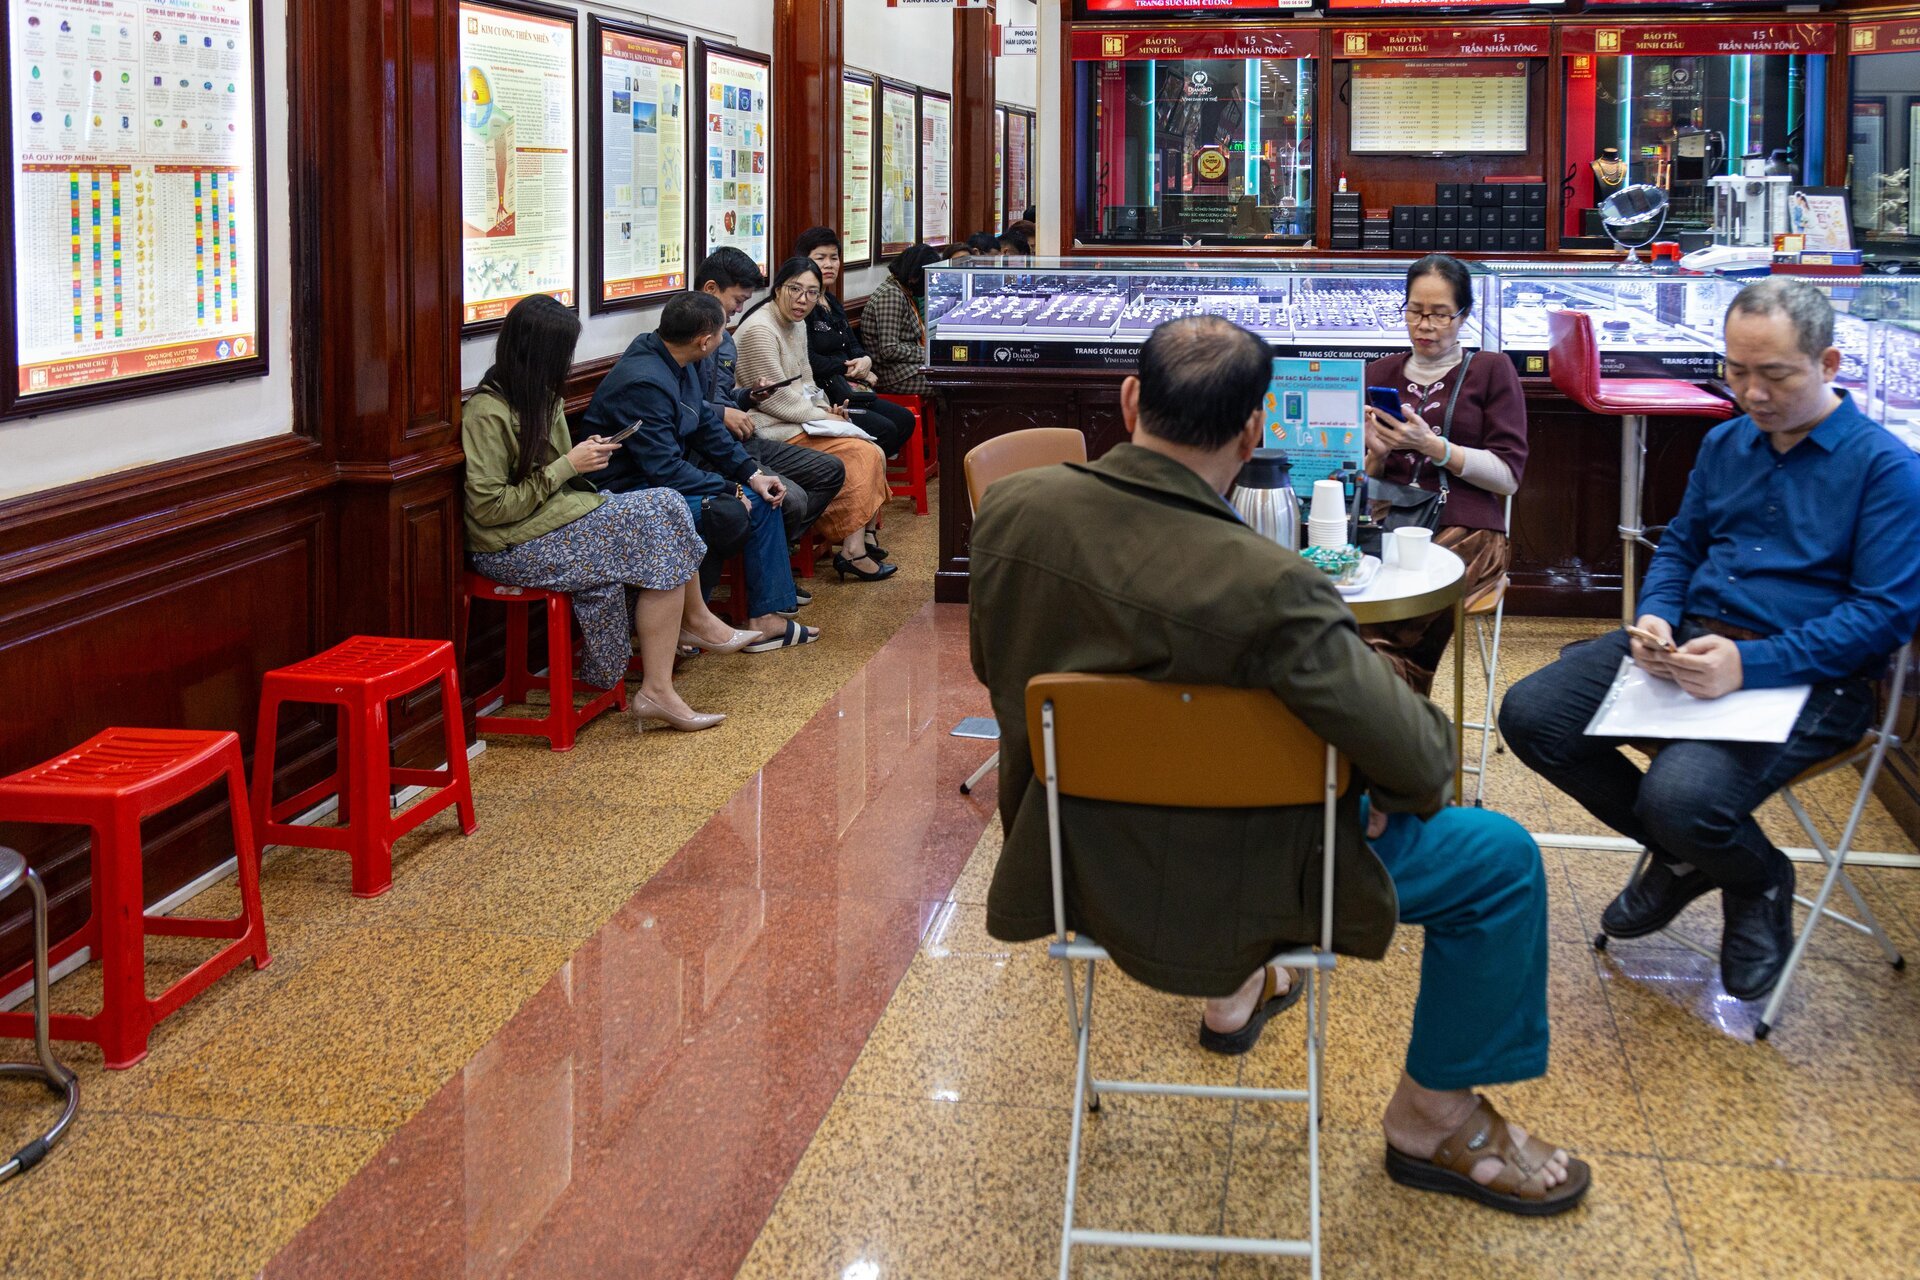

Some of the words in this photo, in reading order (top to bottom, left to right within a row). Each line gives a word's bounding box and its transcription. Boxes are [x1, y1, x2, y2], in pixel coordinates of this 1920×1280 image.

[1390, 34, 1407, 43] BẢO
[1408, 34, 1422, 43] TÍN
[1492, 34, 1505, 42] 15
[1643, 31, 1661, 40] BẢO
[1662, 31, 1678, 40] TÍN
[1752, 31, 1766, 40] 15
[1145, 36, 1162, 45] BẢO
[1164, 36, 1176, 45] TÍN
[1244, 36, 1256, 45] 15
[1660, 40, 1685, 49] CHÂU
[1718, 40, 1742, 50] TRẦN
[1744, 41, 1771, 50] NHÂN
[1773, 41, 1800, 50] TÔNG
[1891, 38, 1915, 46] MINH
[1161, 45, 1183, 54] CHÂU
[1213, 44, 1235, 54] TRẦN
[1237, 45, 1262, 54] NHÂN
[1264, 46, 1287, 54] TÔNG
[1406, 44, 1429, 52] CHÂU
[1460, 43, 1483, 53] TRẦN
[1485, 44, 1511, 52] NHÂN
[1513, 43, 1538, 52] TÔNG
[76, 360, 92, 370] MINH
